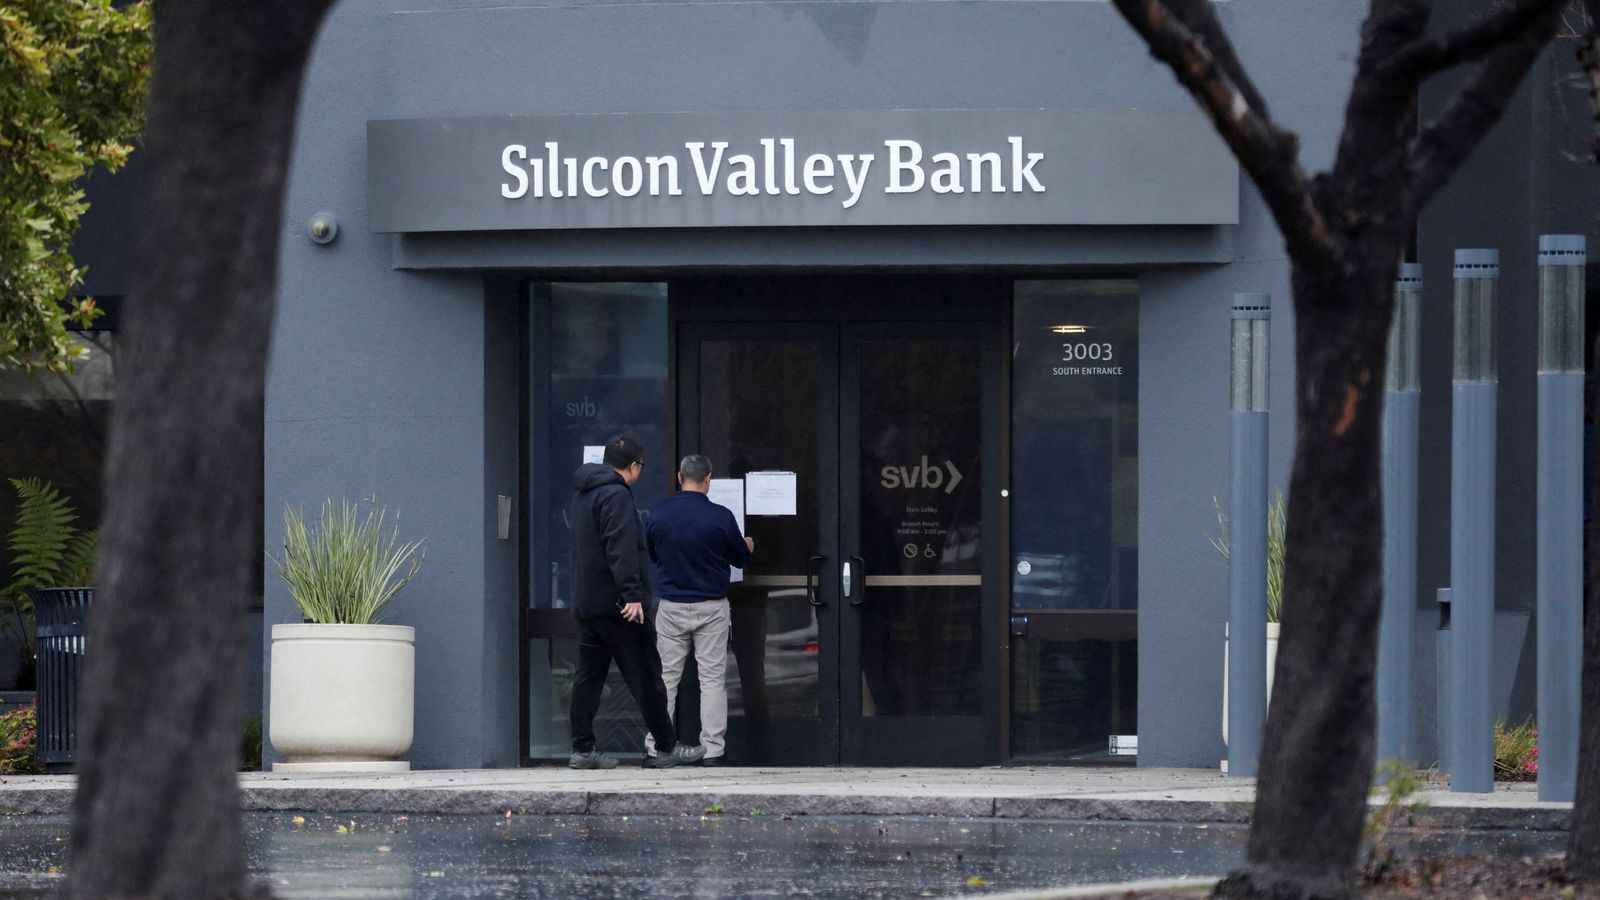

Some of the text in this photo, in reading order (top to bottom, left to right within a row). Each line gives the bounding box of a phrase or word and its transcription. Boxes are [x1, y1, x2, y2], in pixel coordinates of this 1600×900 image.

[685, 138, 874, 210] Valley
[884, 136, 1045, 194] Bank
[1062, 343, 1112, 361] 3003
[1053, 367, 1122, 375] SOUTH ENTRANCE
[566, 395, 596, 417] svb
